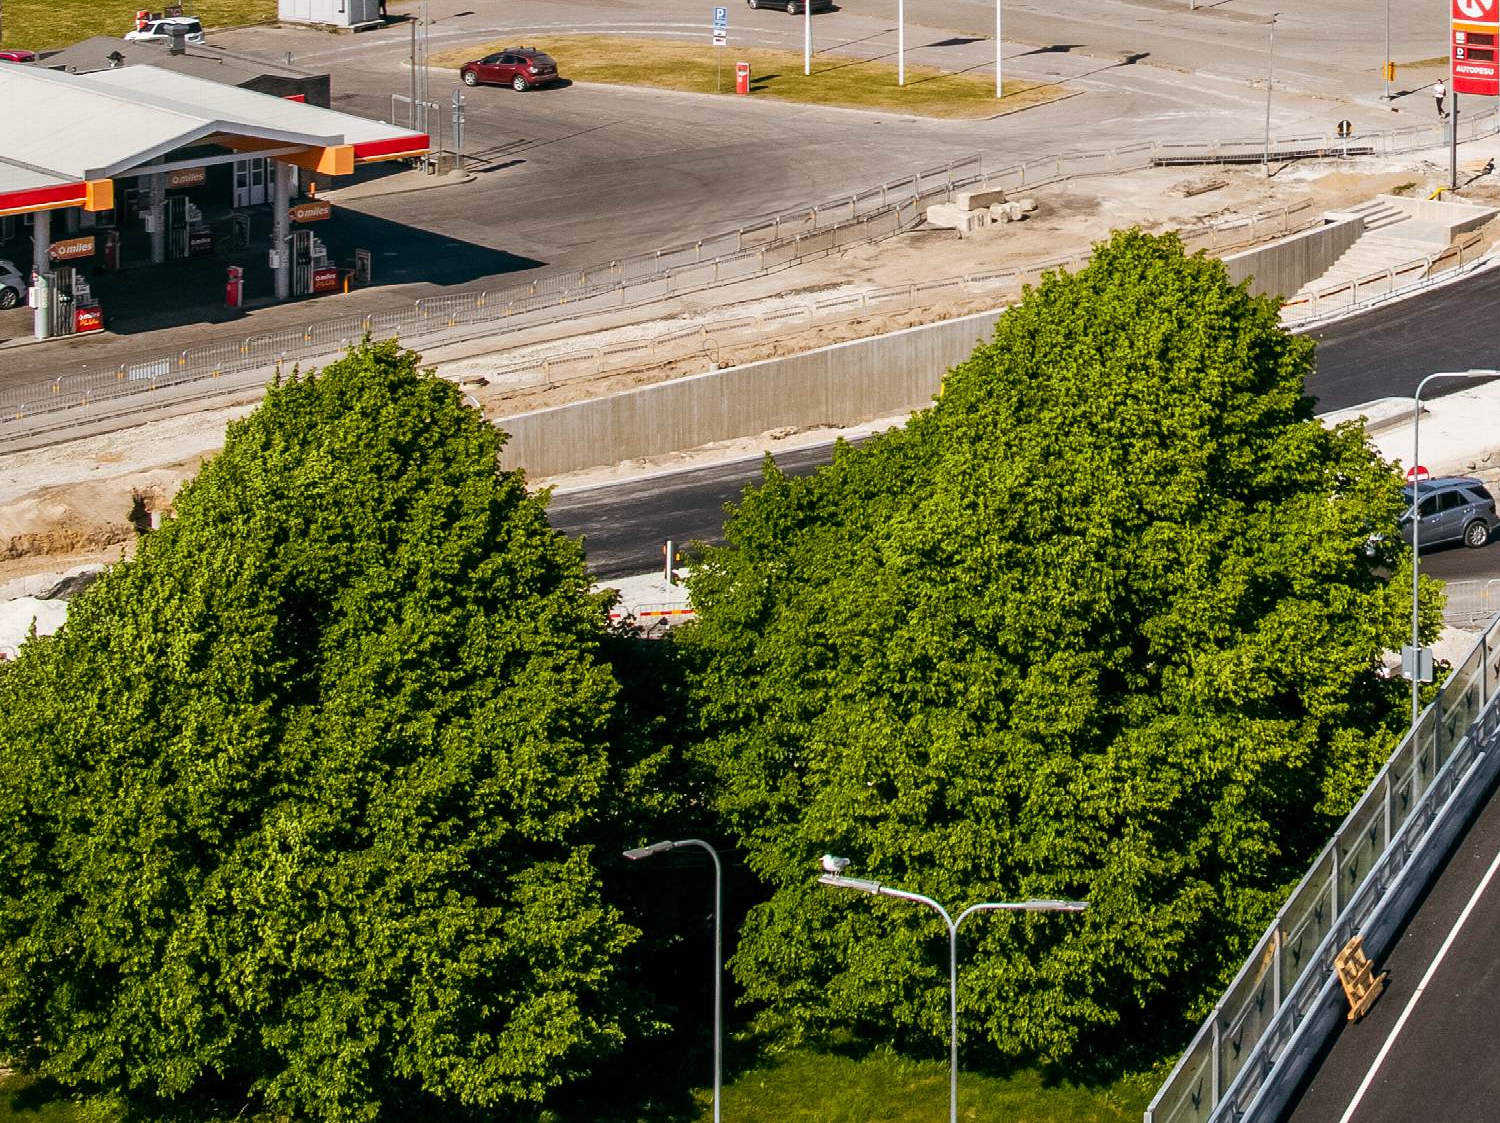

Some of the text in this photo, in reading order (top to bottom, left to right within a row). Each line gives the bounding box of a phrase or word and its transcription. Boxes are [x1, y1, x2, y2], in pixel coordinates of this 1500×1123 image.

[716, 8, 724, 19] P
[1456, 47, 1464, 56] D
[1456, 64, 1495, 75] AUTOPESU
[304, 205, 330, 218] miles
[66, 241, 93, 255] miles
